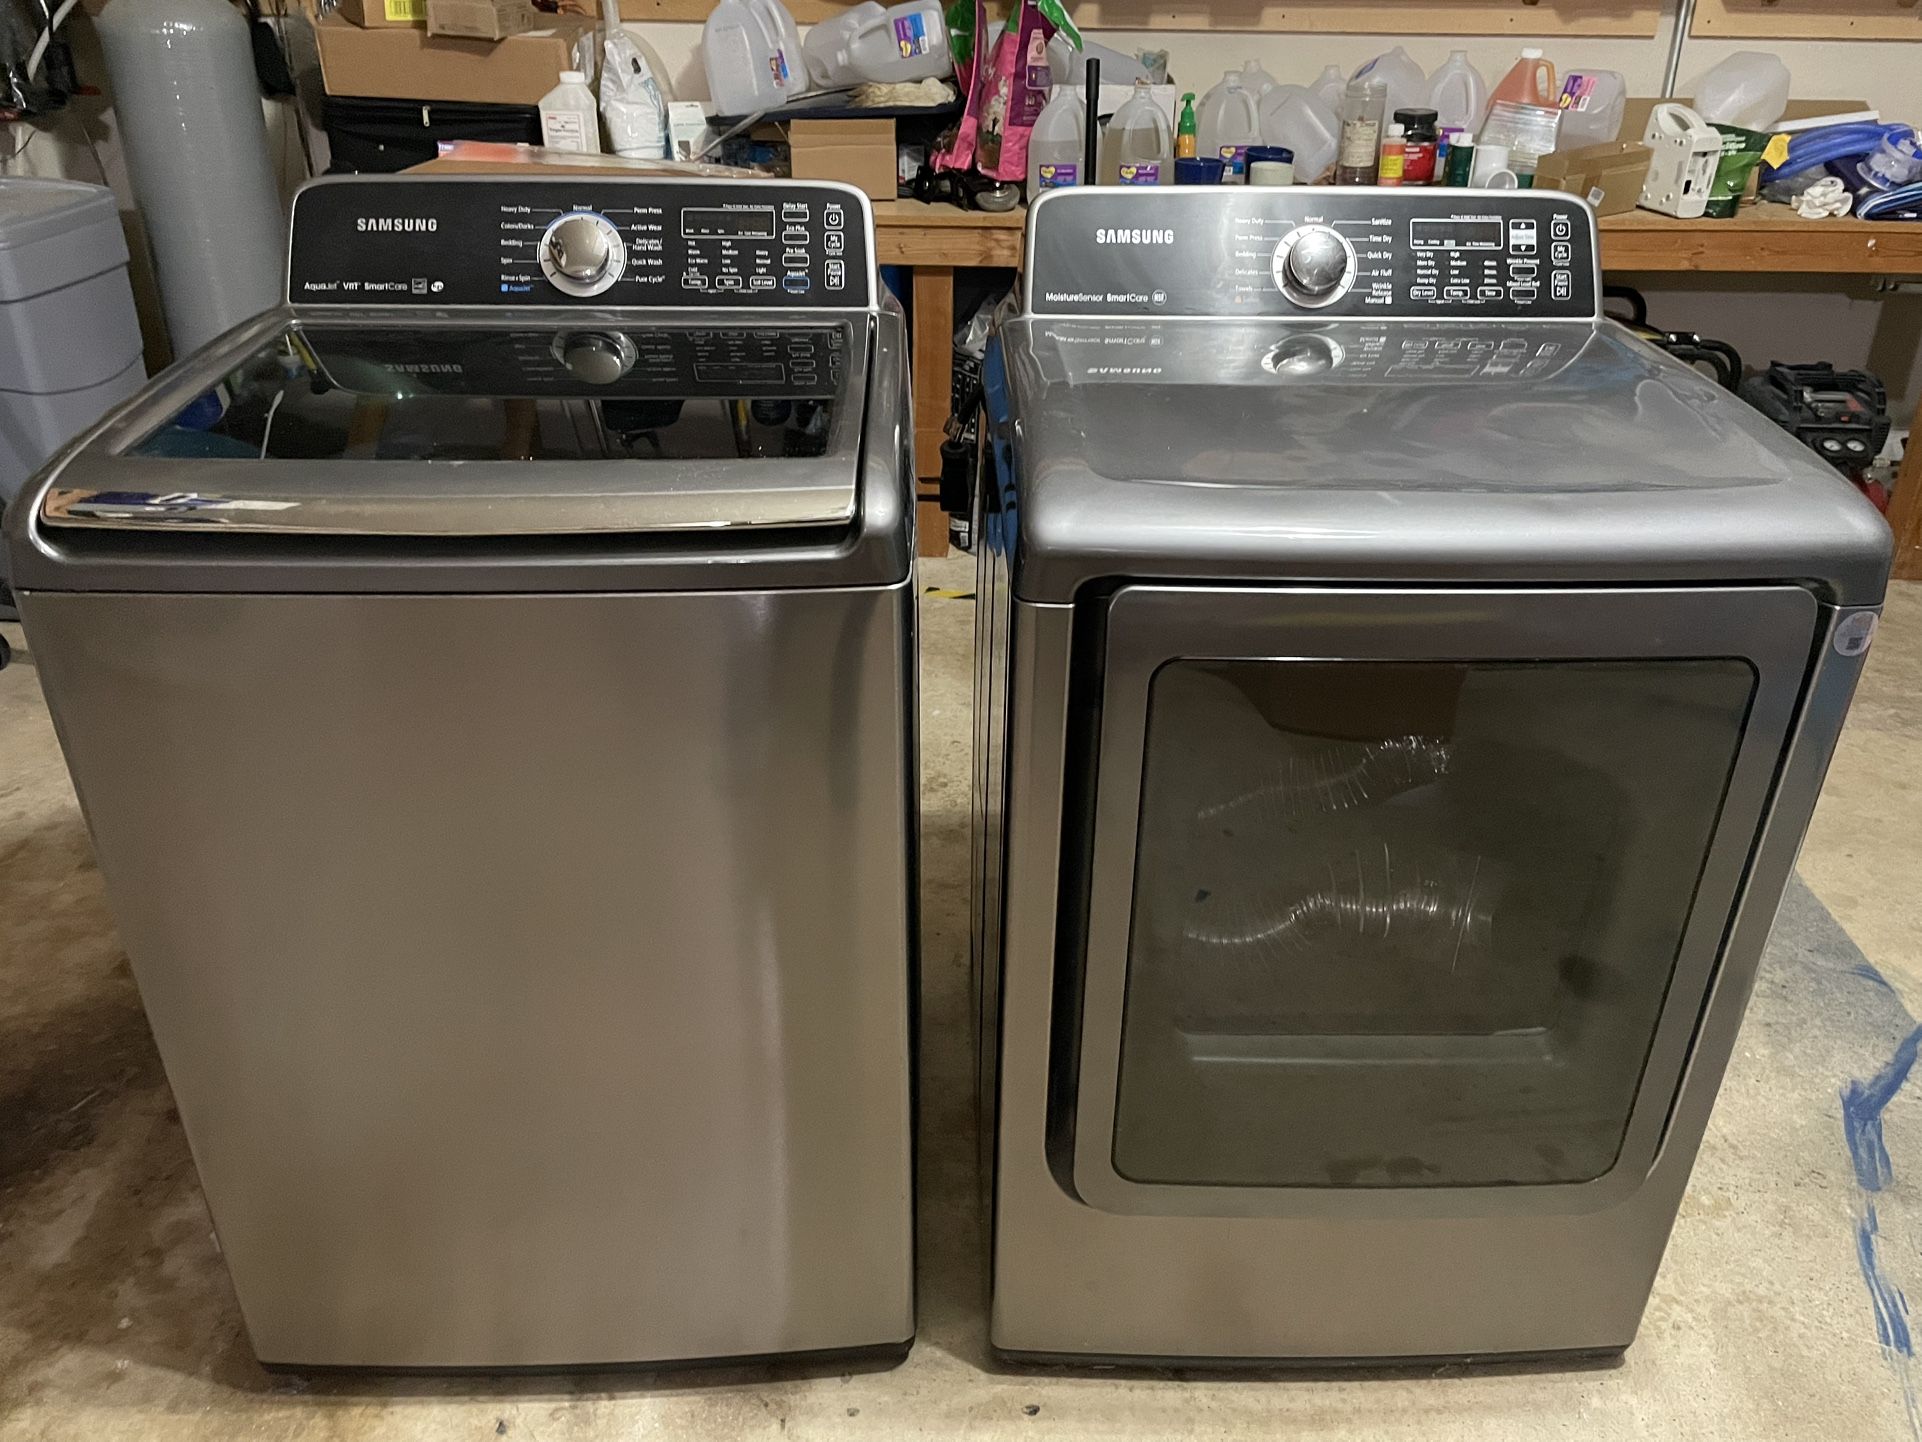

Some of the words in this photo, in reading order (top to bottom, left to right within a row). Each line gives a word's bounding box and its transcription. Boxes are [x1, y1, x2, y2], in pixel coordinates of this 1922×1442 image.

[357, 218, 438, 232] SAMSUNG
[1096, 229, 1174, 244] SAMSUNG
[1045, 292, 1103, 302] MoistureSensor
[1106, 292, 1148, 303] SmartCare
